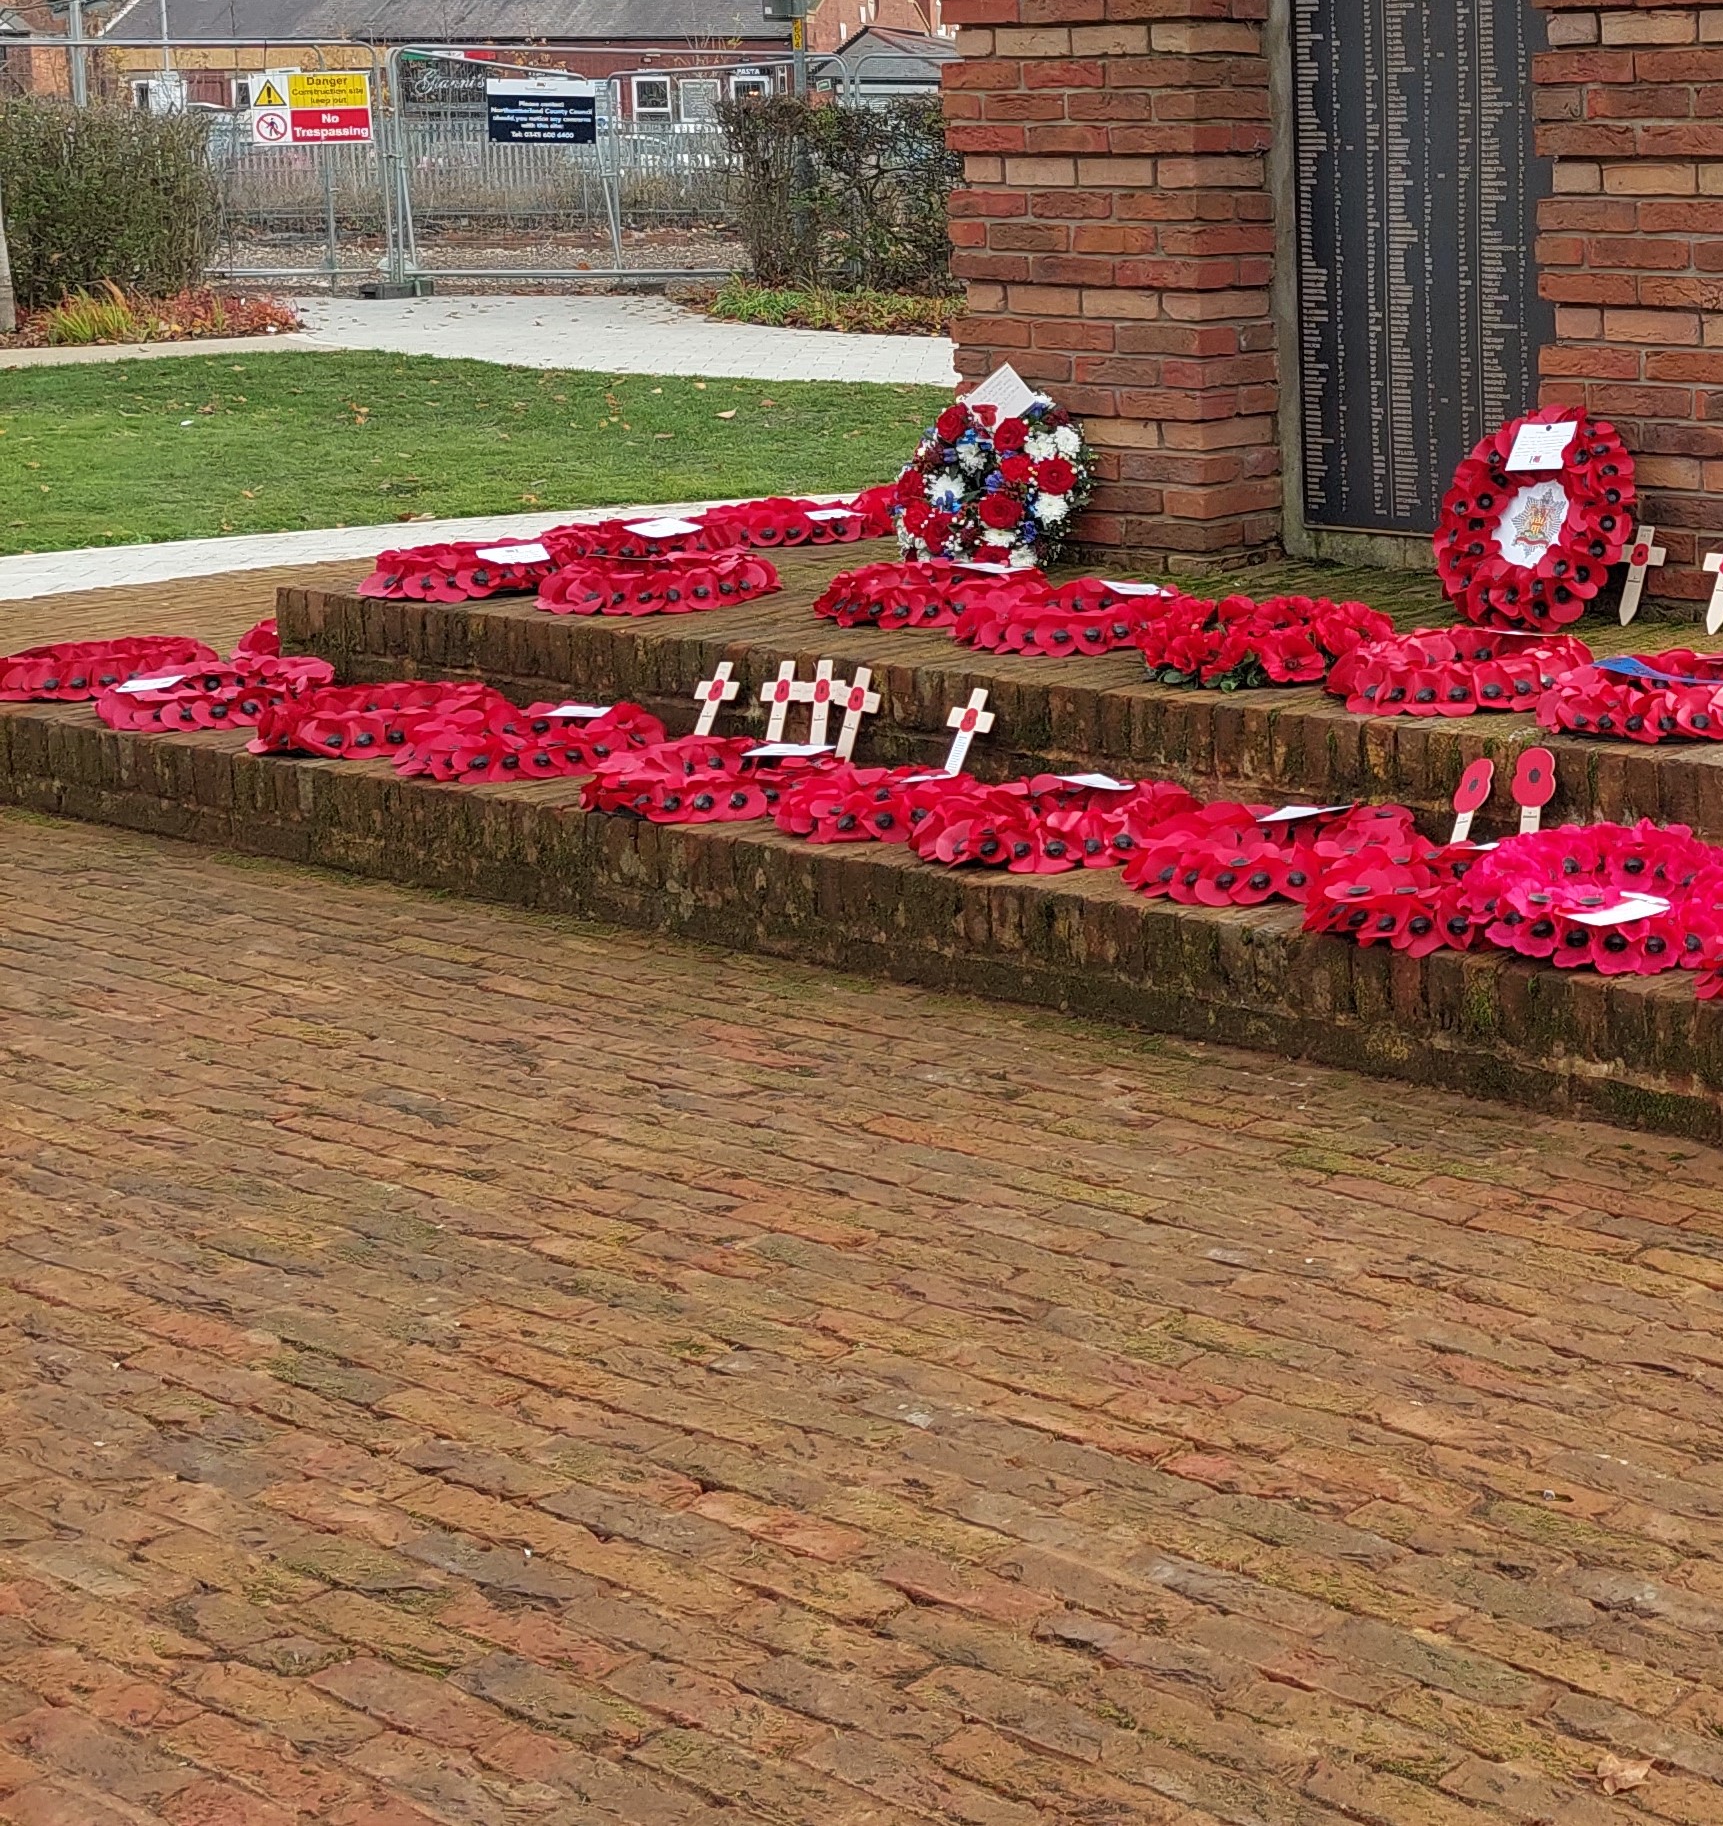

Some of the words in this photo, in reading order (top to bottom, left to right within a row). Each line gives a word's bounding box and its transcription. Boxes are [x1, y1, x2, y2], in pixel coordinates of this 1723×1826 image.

[306, 76, 348, 88] Danger
[414, 67, 485, 96] Gianni's
[291, 88, 347, 96] Construction
[348, 87, 364, 95] site
[310, 96, 331, 105] keep
[490, 106, 544, 114] Northumberland
[544, 108, 568, 116] County
[321, 113, 340, 124] No
[293, 126, 369, 141] Trespassing
